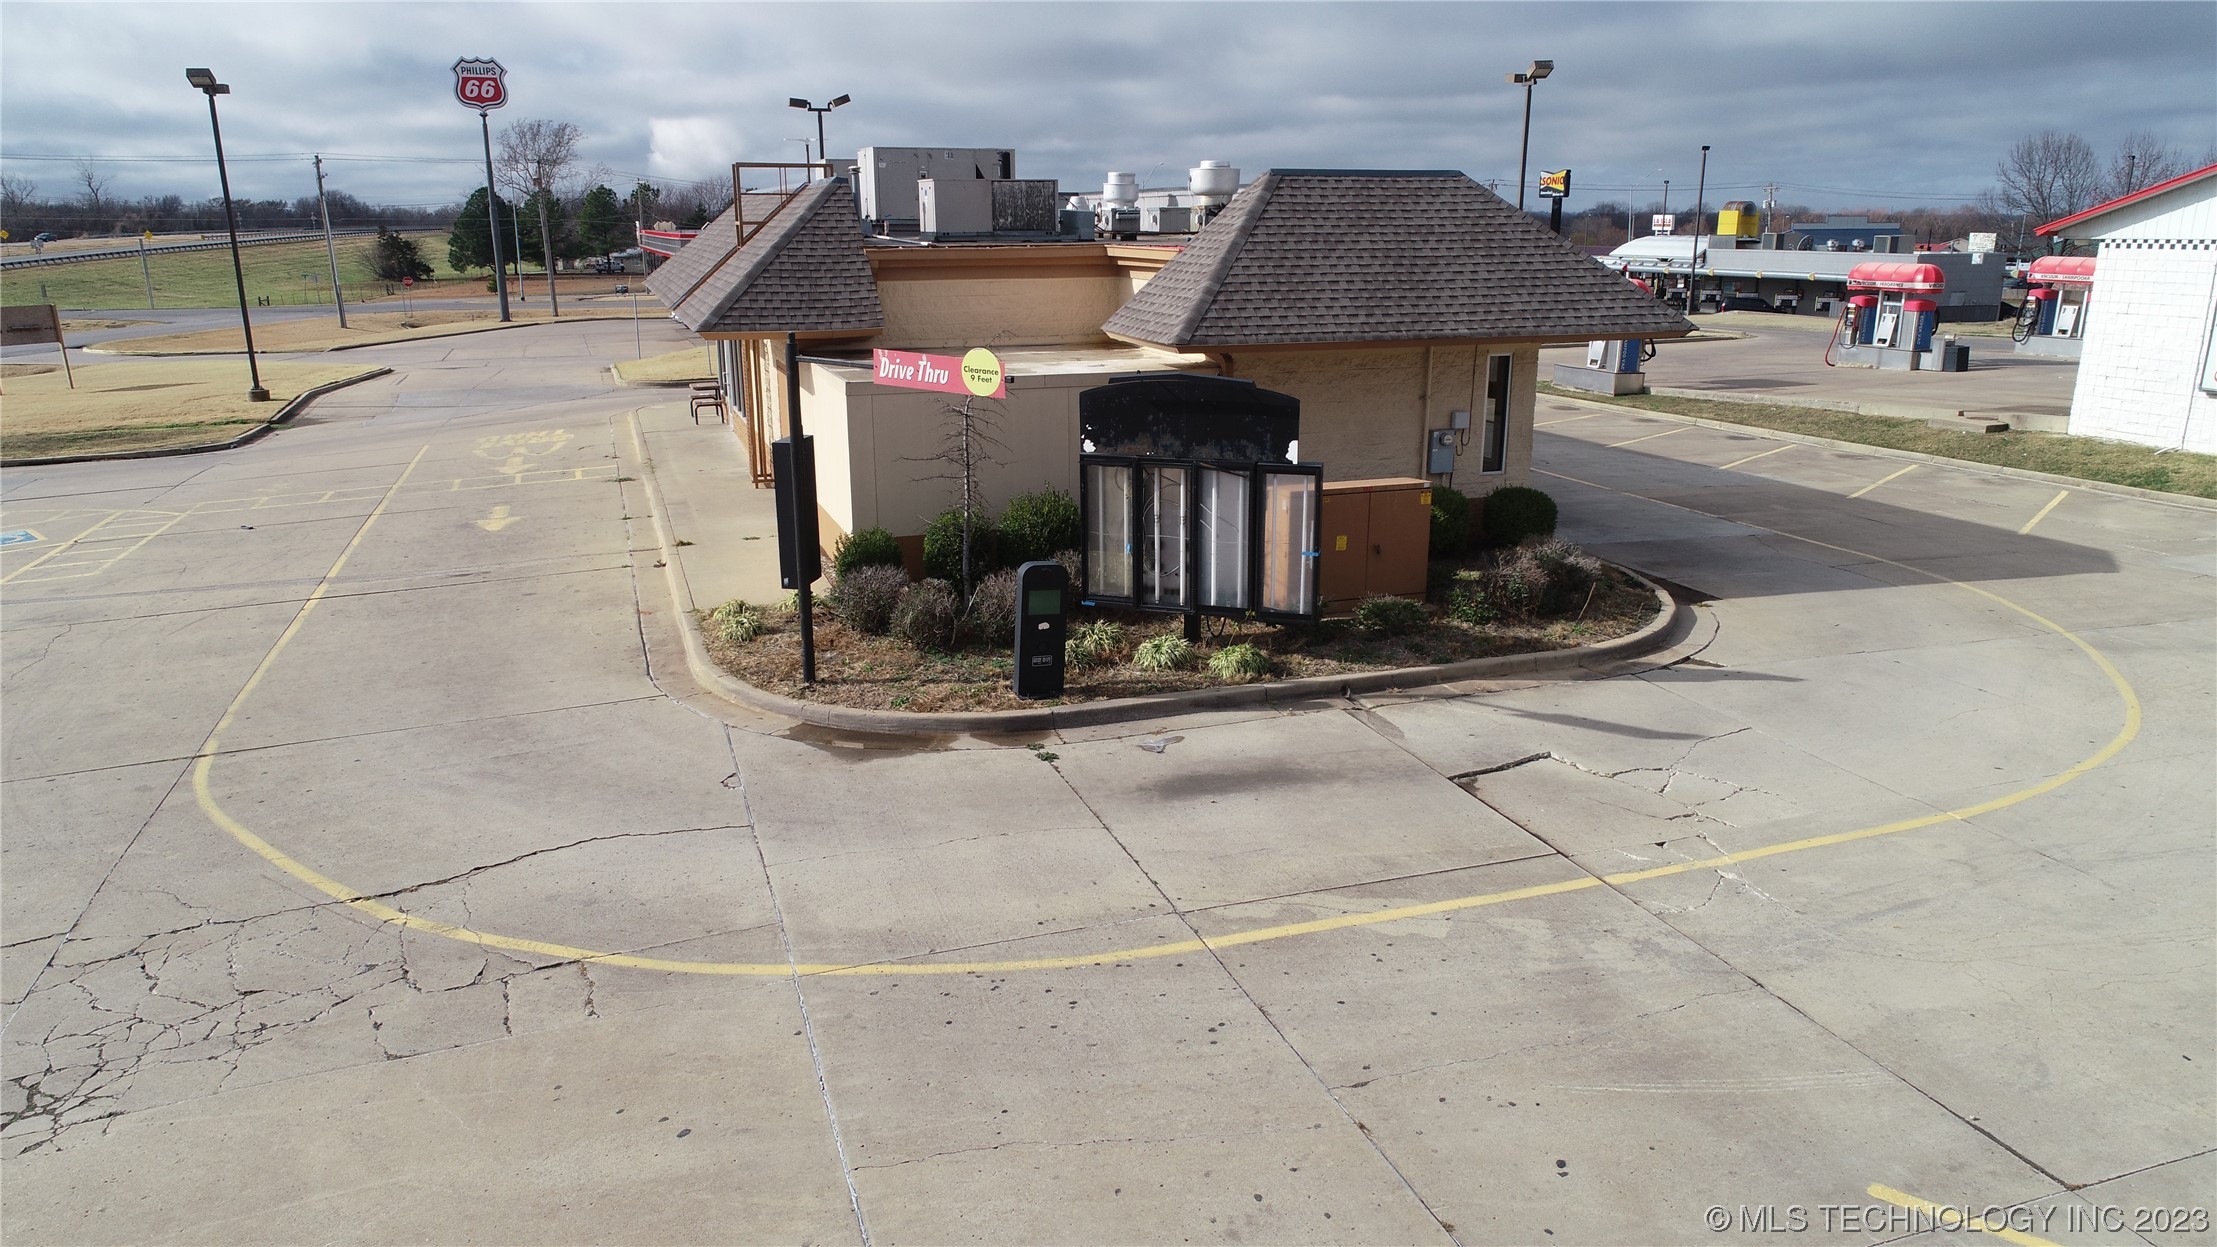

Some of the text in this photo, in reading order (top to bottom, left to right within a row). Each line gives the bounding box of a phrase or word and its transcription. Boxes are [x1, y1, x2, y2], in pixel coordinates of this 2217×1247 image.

[460, 66, 496, 76] PHILLIPS
[465, 80, 496, 98] 66
[1541, 176, 1564, 186] SONIC
[879, 357, 949, 384] Drive Thru
[964, 365, 999, 376] Clearance
